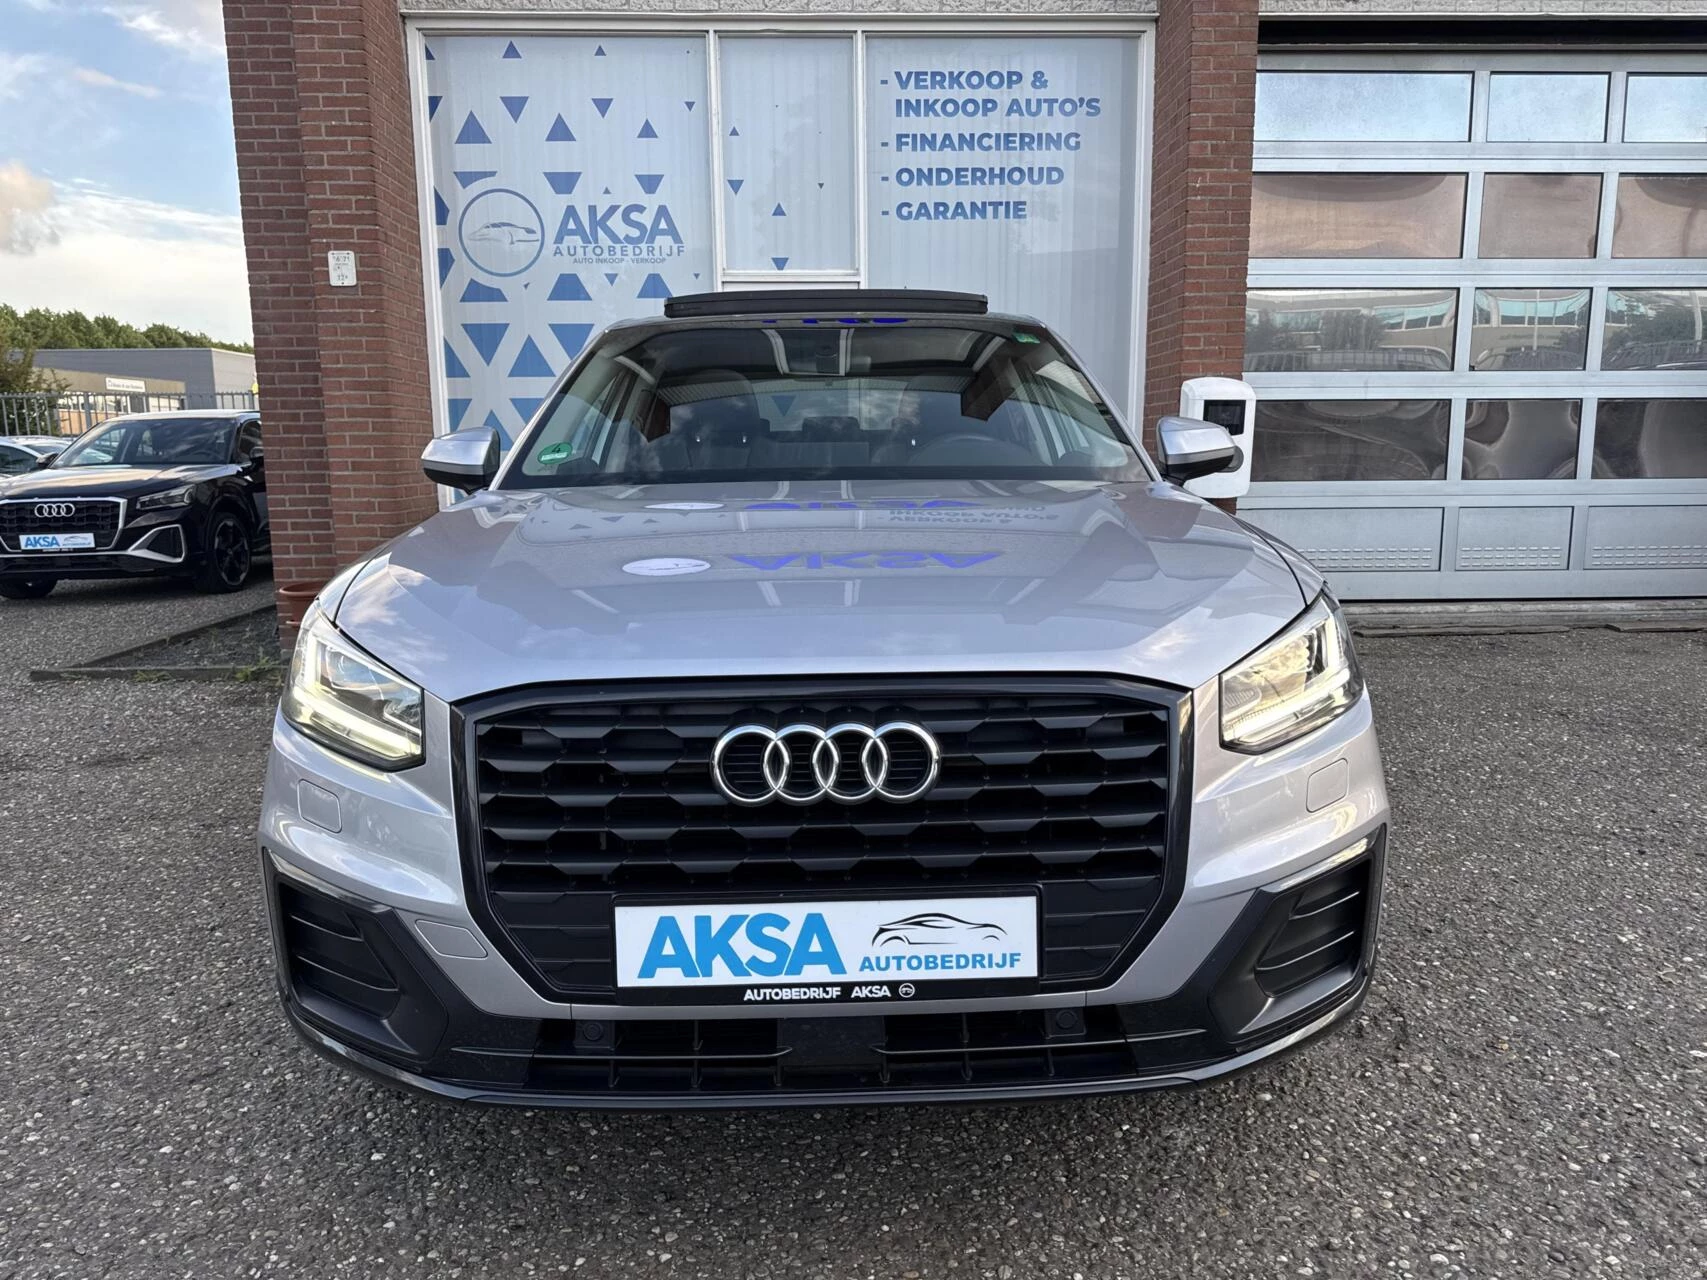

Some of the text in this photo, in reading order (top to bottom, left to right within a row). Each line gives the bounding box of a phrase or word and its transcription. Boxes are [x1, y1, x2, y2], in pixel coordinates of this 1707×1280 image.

[894, 70, 1024, 90] VERKOOP
[1031, 70, 1049, 90] &
[895, 97, 1101, 118] INKOOP AUTO'S
[895, 132, 1081, 152] FINANCIERING
[895, 166, 1065, 187] ONDERHOUD
[895, 201, 1028, 221] GARANTIE
[553, 203, 685, 245] AKSA
[553, 245, 686, 257] AUTOBEDRIJF
[630, 257, 666, 265] VERKOOP
[25, 536, 60, 548] AKSA
[637, 912, 847, 978] AKSA
[859, 952, 1022, 972] AUTOBEDRIJF
[743, 985, 892, 1001] AUTOBEDRIJF AKSA
